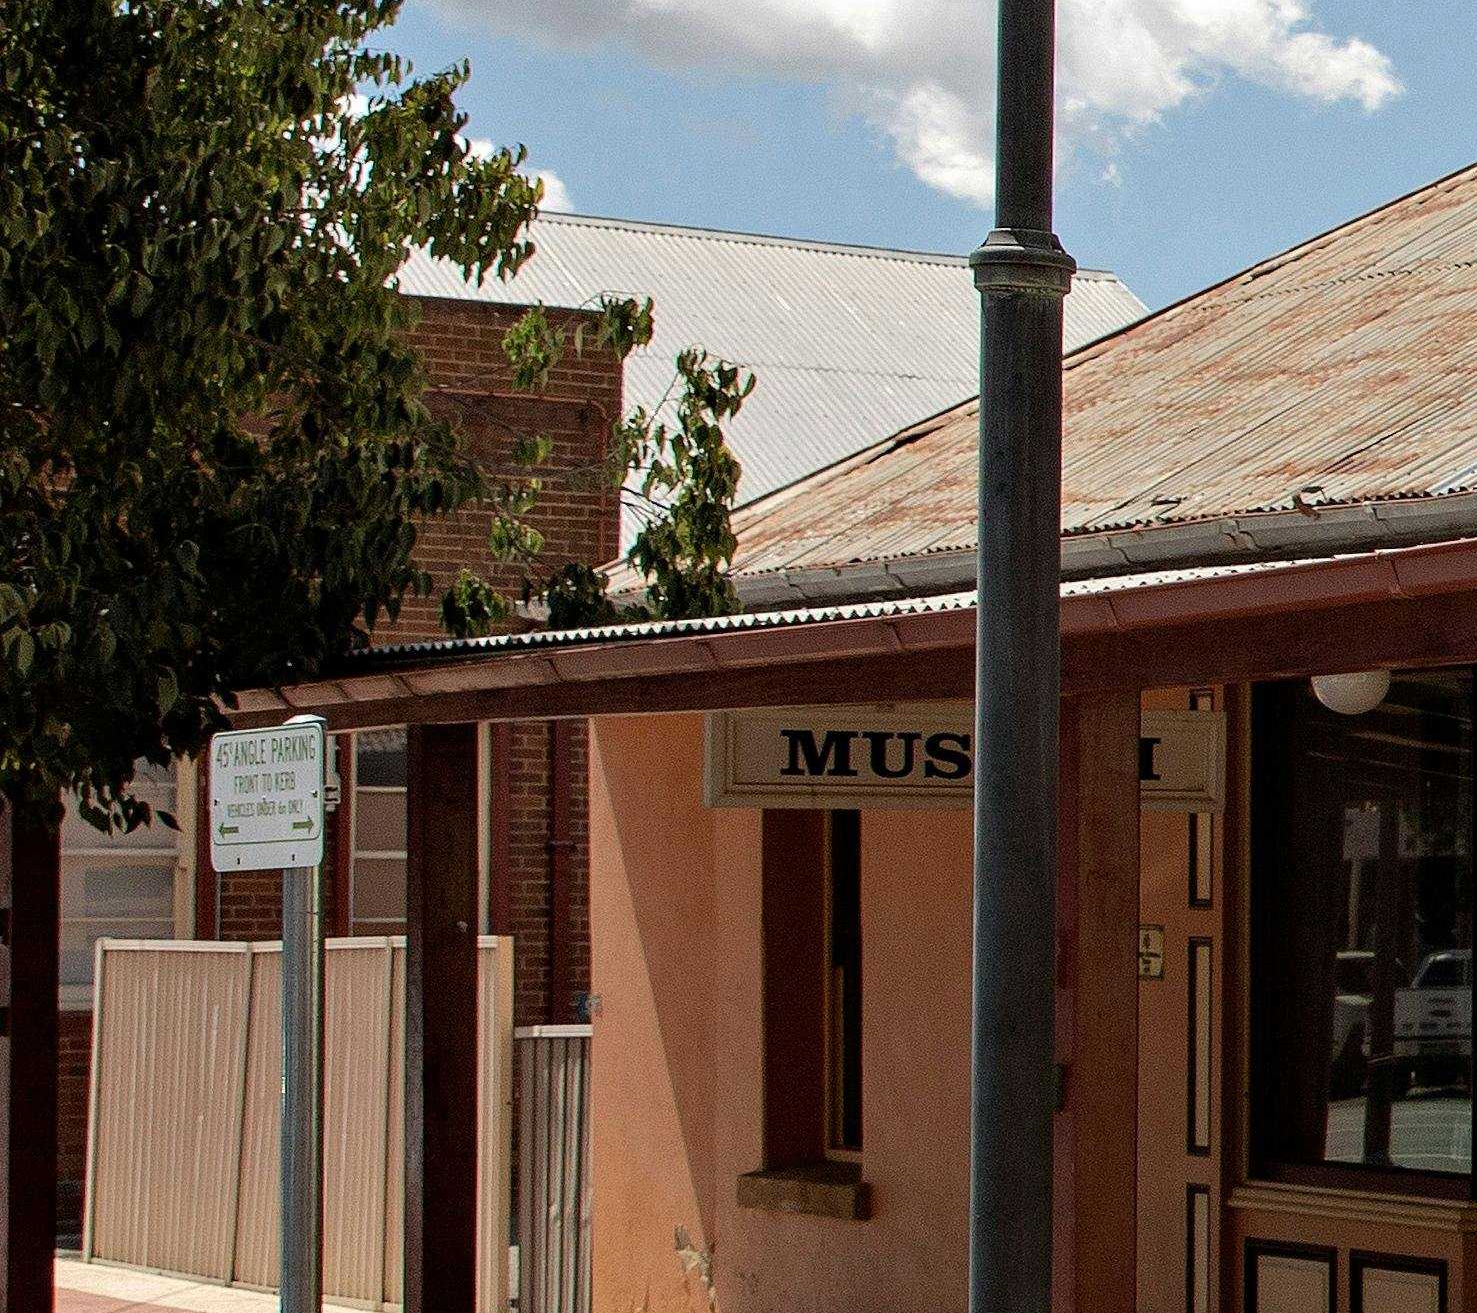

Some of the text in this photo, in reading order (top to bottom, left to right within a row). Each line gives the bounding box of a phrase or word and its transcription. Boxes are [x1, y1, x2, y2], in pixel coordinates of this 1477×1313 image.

[271, 734, 316, 763] PARKING
[780, 729, 1161, 780] MUS
[234, 771, 296, 794] FRONT TO KERB
